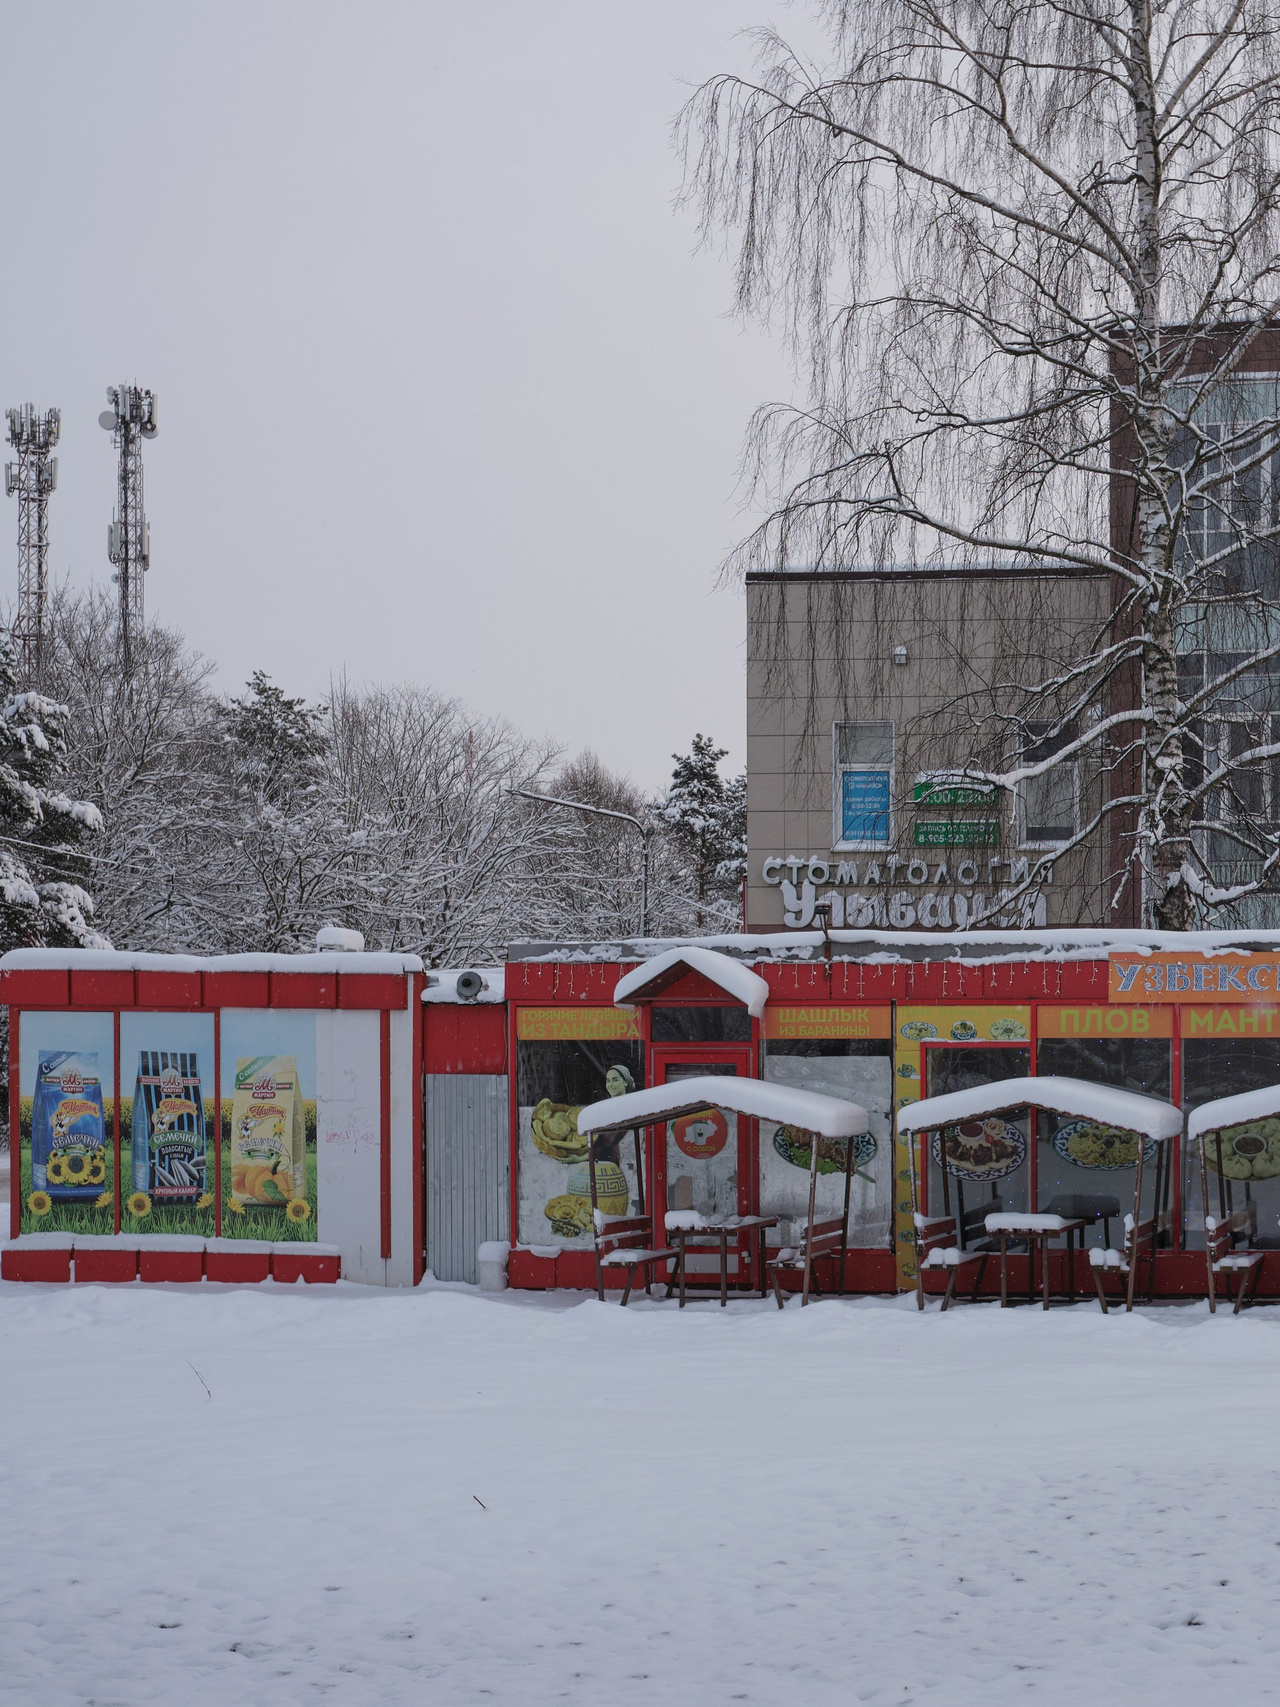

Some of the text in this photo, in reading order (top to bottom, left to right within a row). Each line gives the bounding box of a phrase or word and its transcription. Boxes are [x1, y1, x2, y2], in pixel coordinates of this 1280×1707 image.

[521, 1010, 577, 1022] ГОРЯЧИЕ
[778, 1008, 870, 1022] ШАШЛЫК
[1059, 1009, 1151, 1033] ПЛОВ
[522, 1023, 640, 1039] ИЗ ТАНДЫРА
[778, 1024, 871, 1037] ИЗ БАРАНИНЫ
[154, 1131, 198, 1144] СЕМЕЧКИ
[693, 1144, 716, 1152] СОБОЙ
